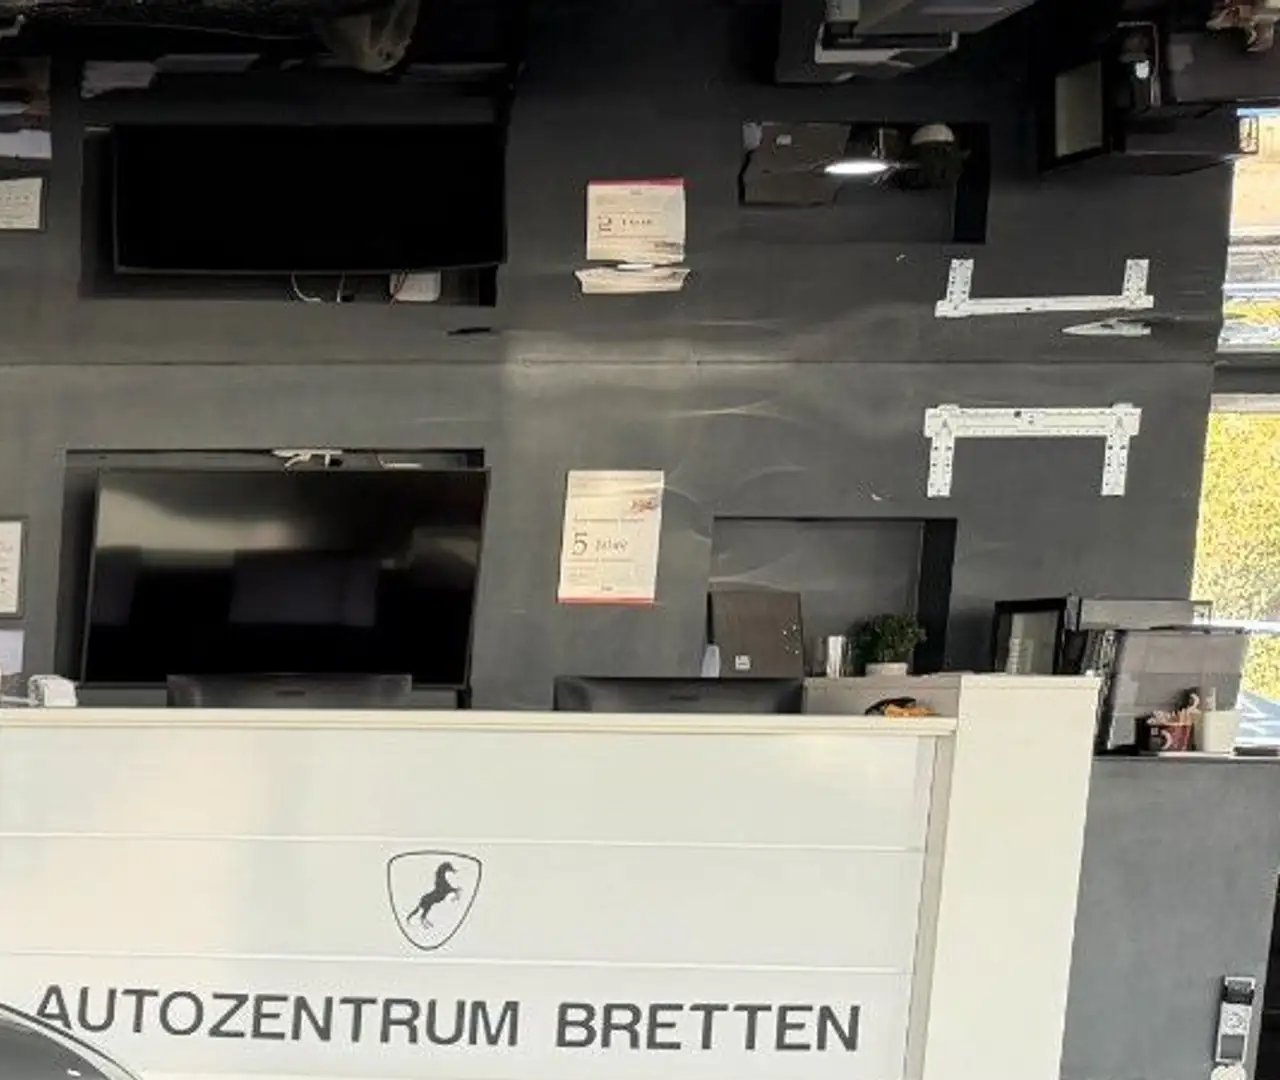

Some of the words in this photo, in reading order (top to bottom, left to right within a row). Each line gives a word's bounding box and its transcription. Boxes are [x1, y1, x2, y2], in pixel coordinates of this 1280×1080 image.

[572, 530, 588, 556] 5
[37, 984, 520, 1047] AUTOZENTRUM
[555, 1001, 861, 1052] BRETTEN
